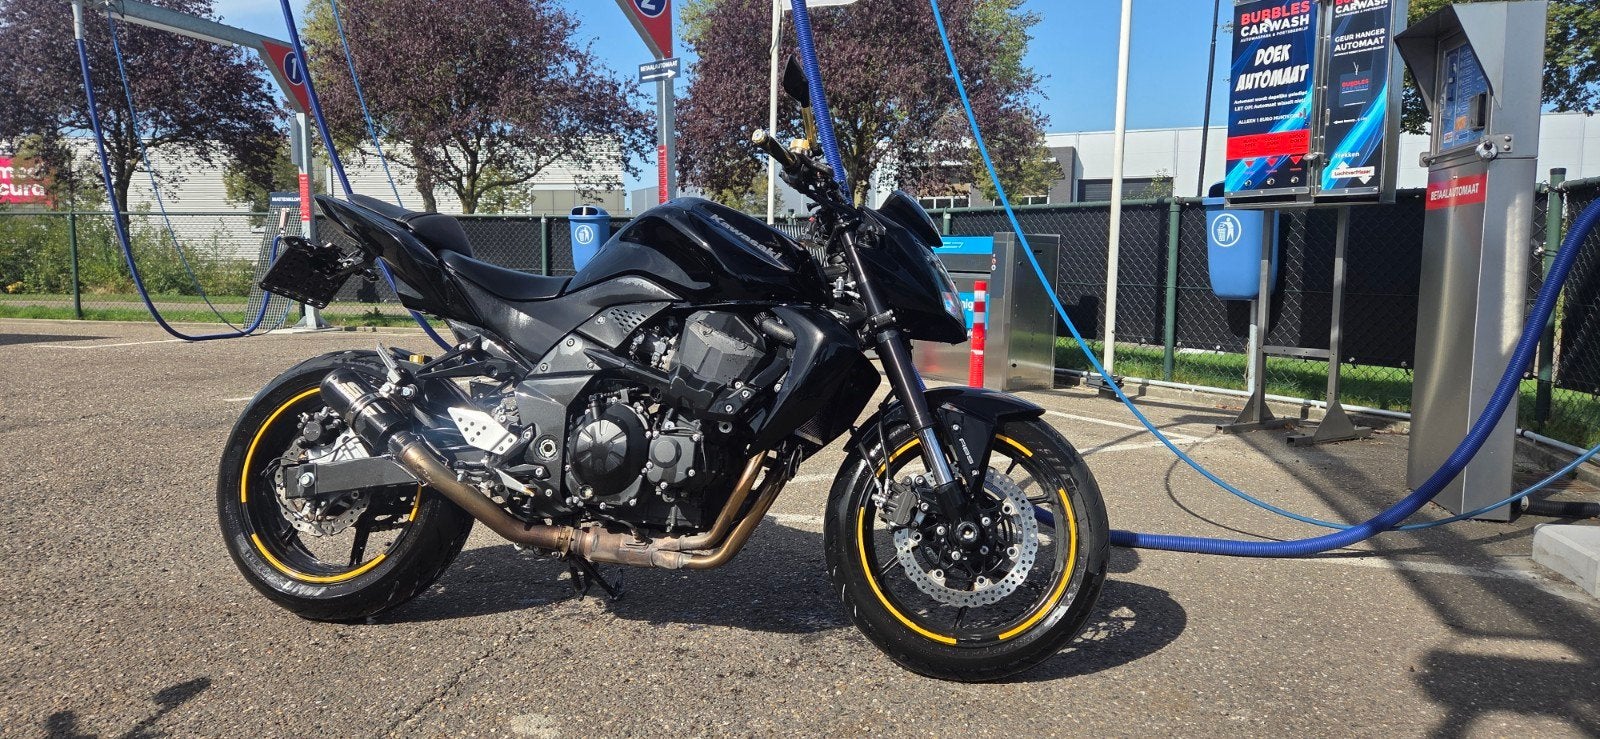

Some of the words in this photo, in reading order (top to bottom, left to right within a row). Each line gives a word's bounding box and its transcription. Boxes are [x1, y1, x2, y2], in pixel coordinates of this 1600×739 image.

[1241, 1, 1310, 25] BUBBLES
[1240, 14, 1310, 37] CARWASH
[1334, 34, 1354, 43] GEUR
[1355, 28, 1385, 39] HANGER
[1254, 44, 1292, 66] DOEK
[1334, 36, 1385, 52] AUTOMAAT
[291, 57, 298, 80] 1
[1235, 63, 1310, 92] AUTOMAAT
[1431, 183, 1480, 201] BETAALAUTOMAAT
[710, 214, 783, 260] Kawasaki
[958, 437, 975, 465] ABS
